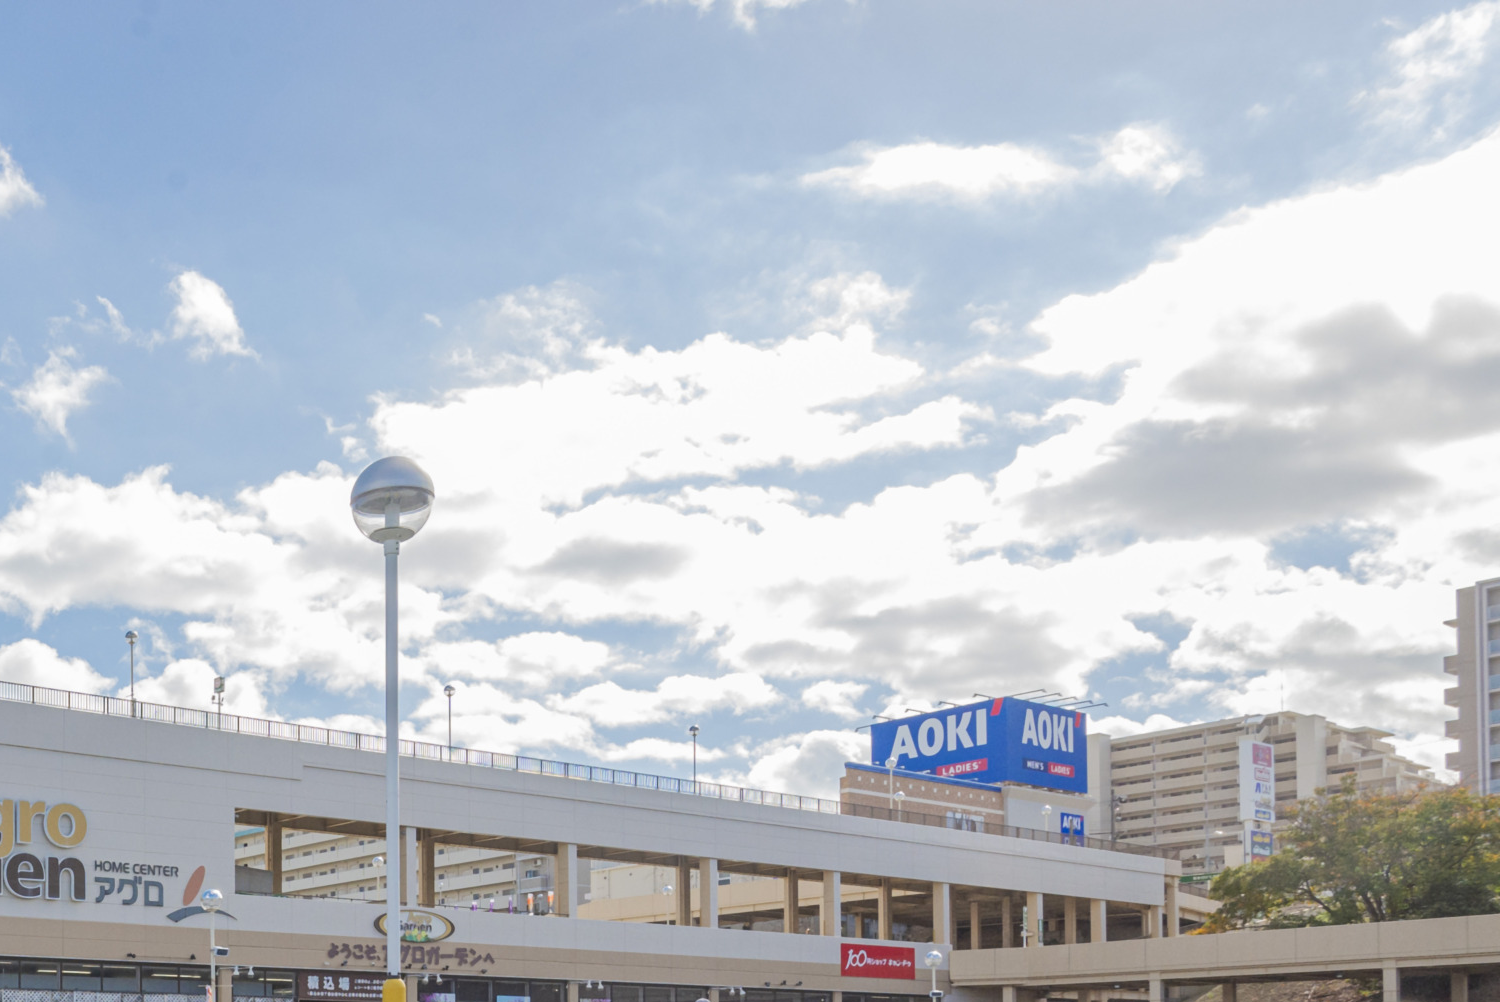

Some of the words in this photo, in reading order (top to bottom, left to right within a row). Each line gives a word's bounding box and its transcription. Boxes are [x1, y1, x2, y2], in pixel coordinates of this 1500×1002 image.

[890, 708, 987, 760] AOKI
[1022, 708, 1074, 753] AOKI
[1026, 760, 1044, 771] MEN'S
[94, 860, 130, 874] HOME
[132, 863, 179, 877] CENTER
[94, 876, 164, 907] アグロ
